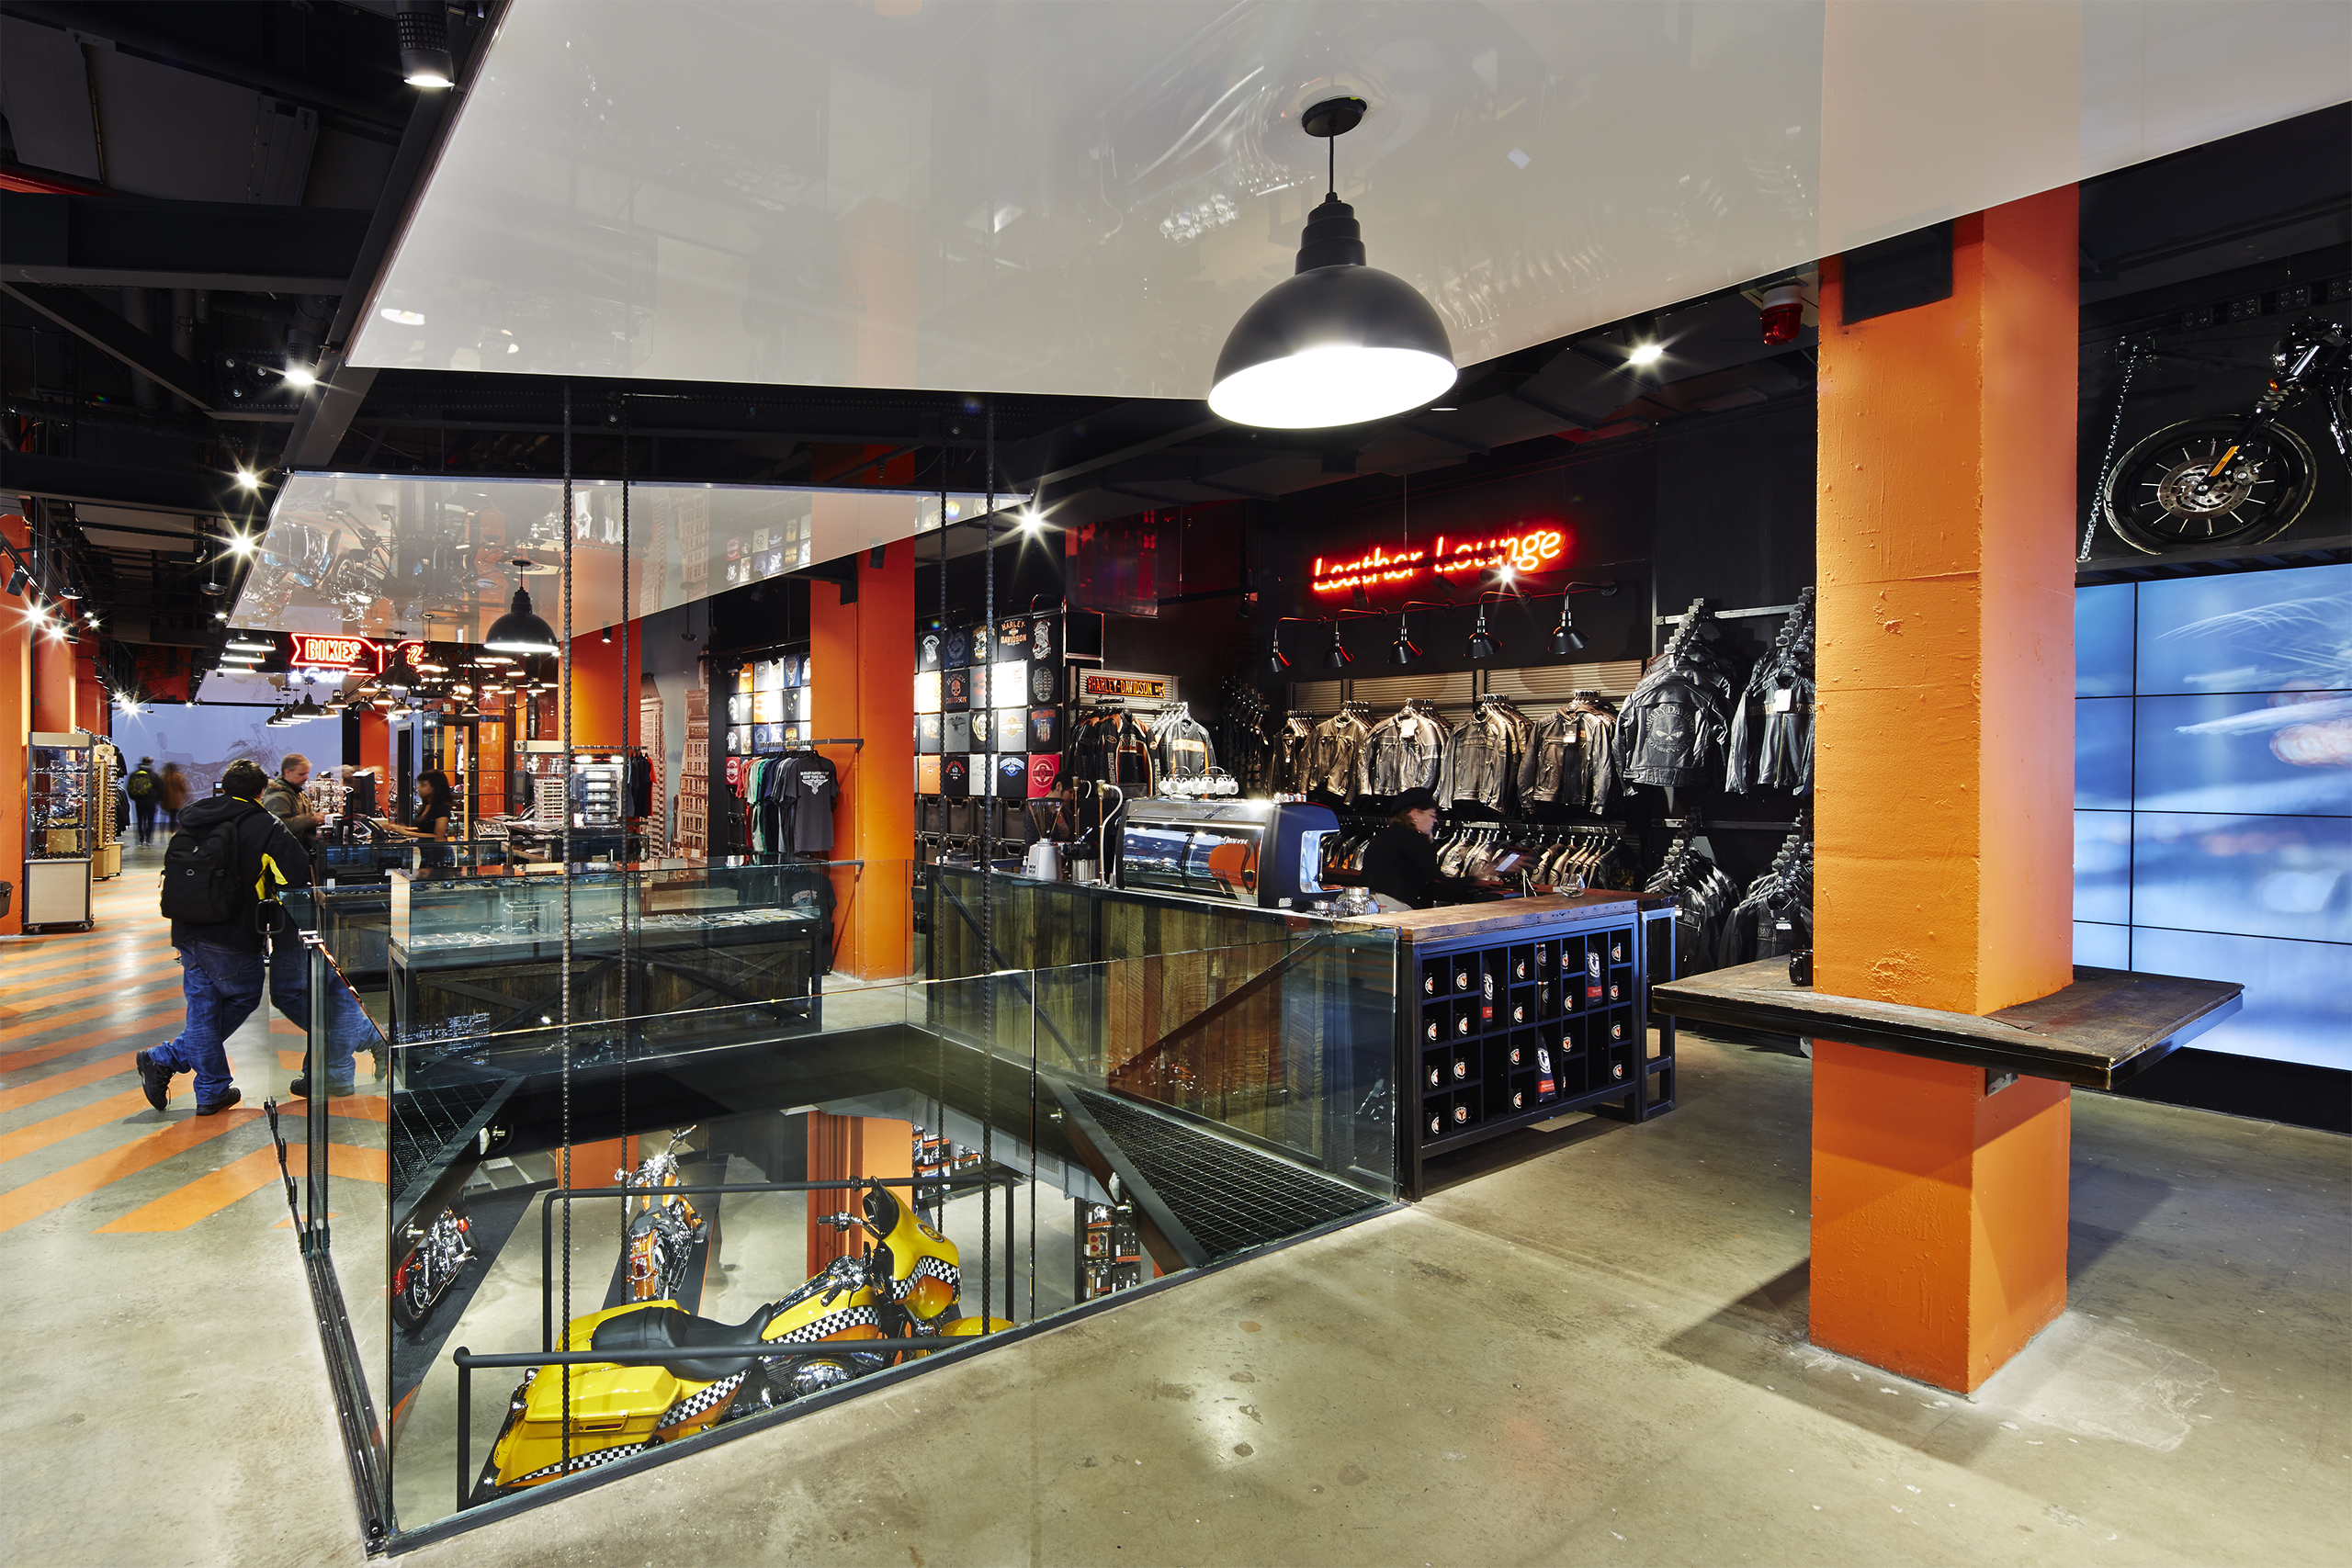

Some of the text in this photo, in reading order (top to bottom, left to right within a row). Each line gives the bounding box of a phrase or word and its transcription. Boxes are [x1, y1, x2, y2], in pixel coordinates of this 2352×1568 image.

[1313, 530, 1561, 591] Leather Lounge
[1001, 634, 1027, 644] DAVIDSON
[305, 638, 362, 662] BIKES
[1091, 677, 1153, 695] HARLEY-DAVIDSON
